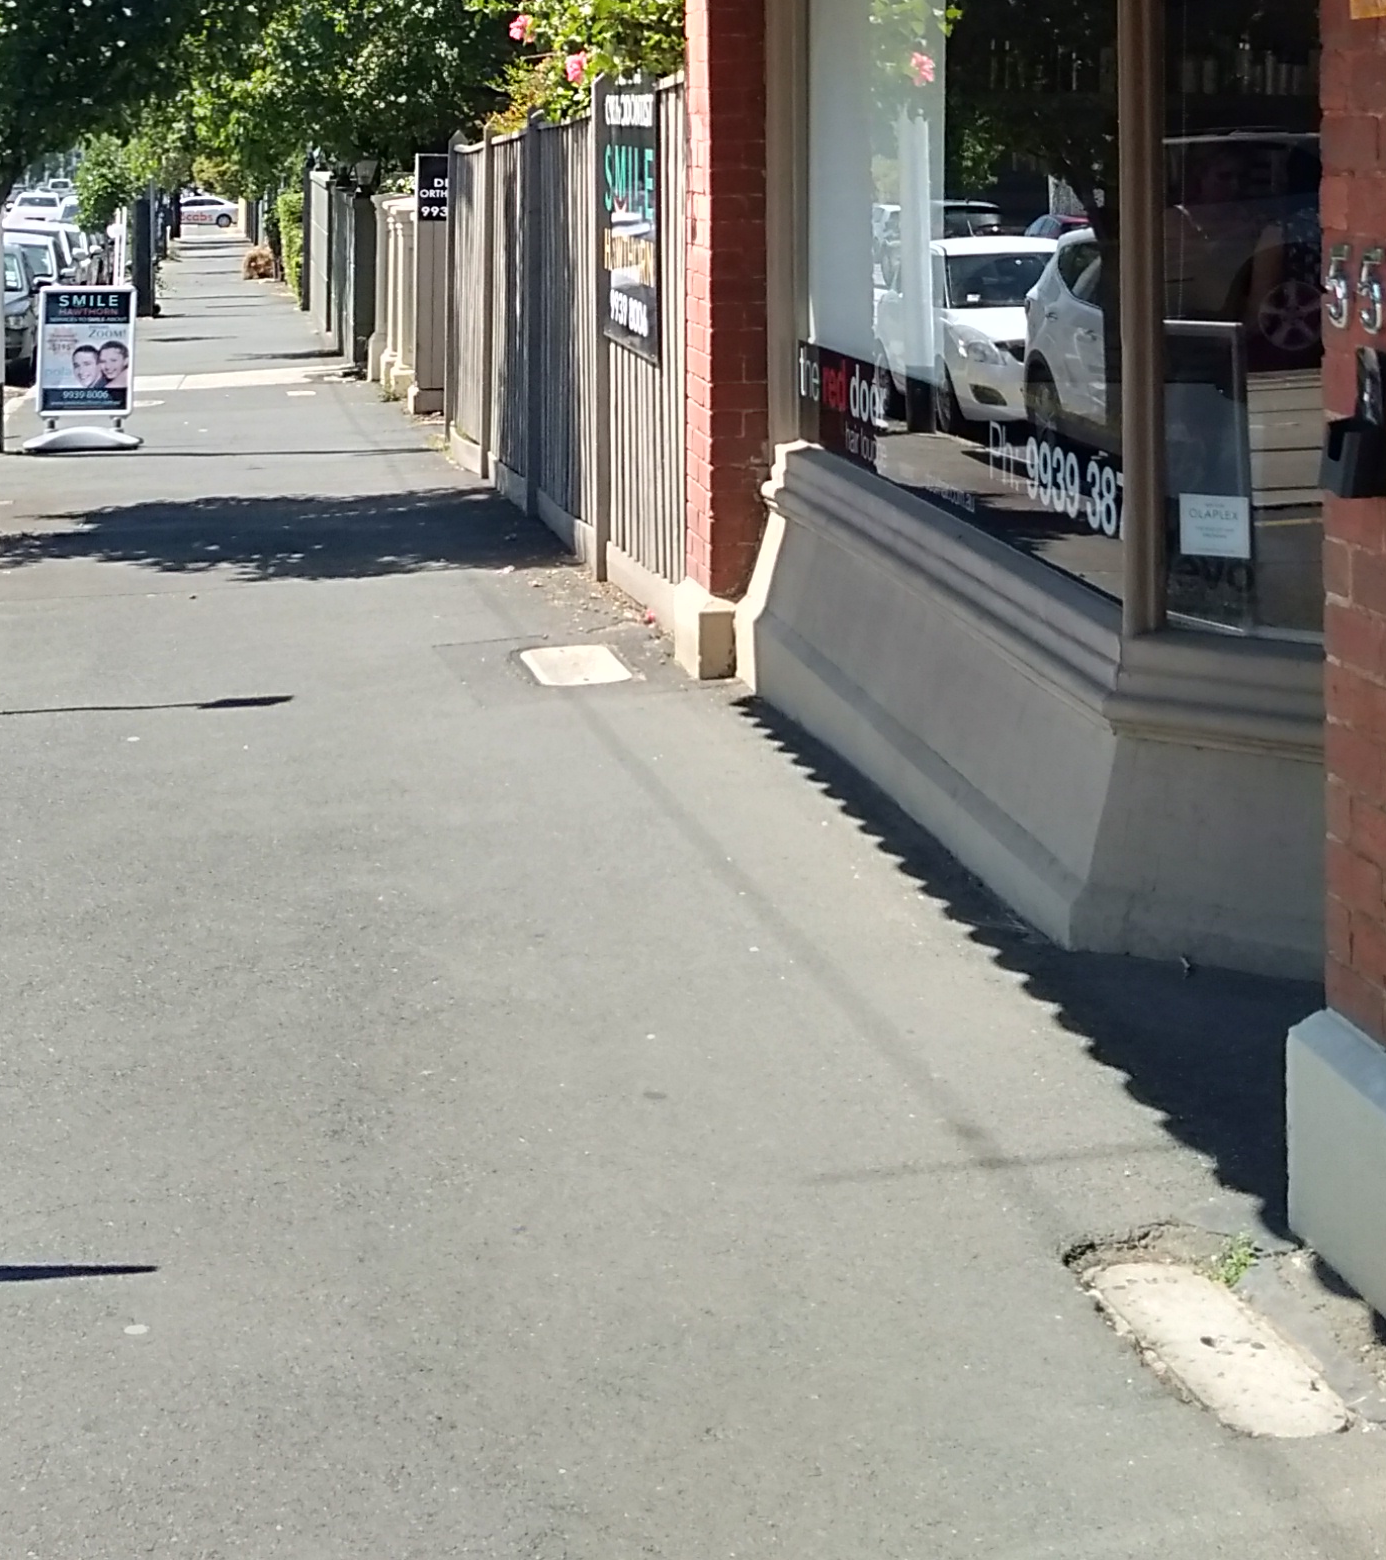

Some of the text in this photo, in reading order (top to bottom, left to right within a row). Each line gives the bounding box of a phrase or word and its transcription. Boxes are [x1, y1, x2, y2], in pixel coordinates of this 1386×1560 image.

[605, 144, 654, 221] SMILE
[58, 295, 119, 307] SMILE
[59, 308, 118, 316] HAWTHORN
[62, 390, 109, 399] 9939 8006
[799, 347, 820, 401] the
[822, 359, 846, 412] red
[1025, 437, 1080, 519] 9939
